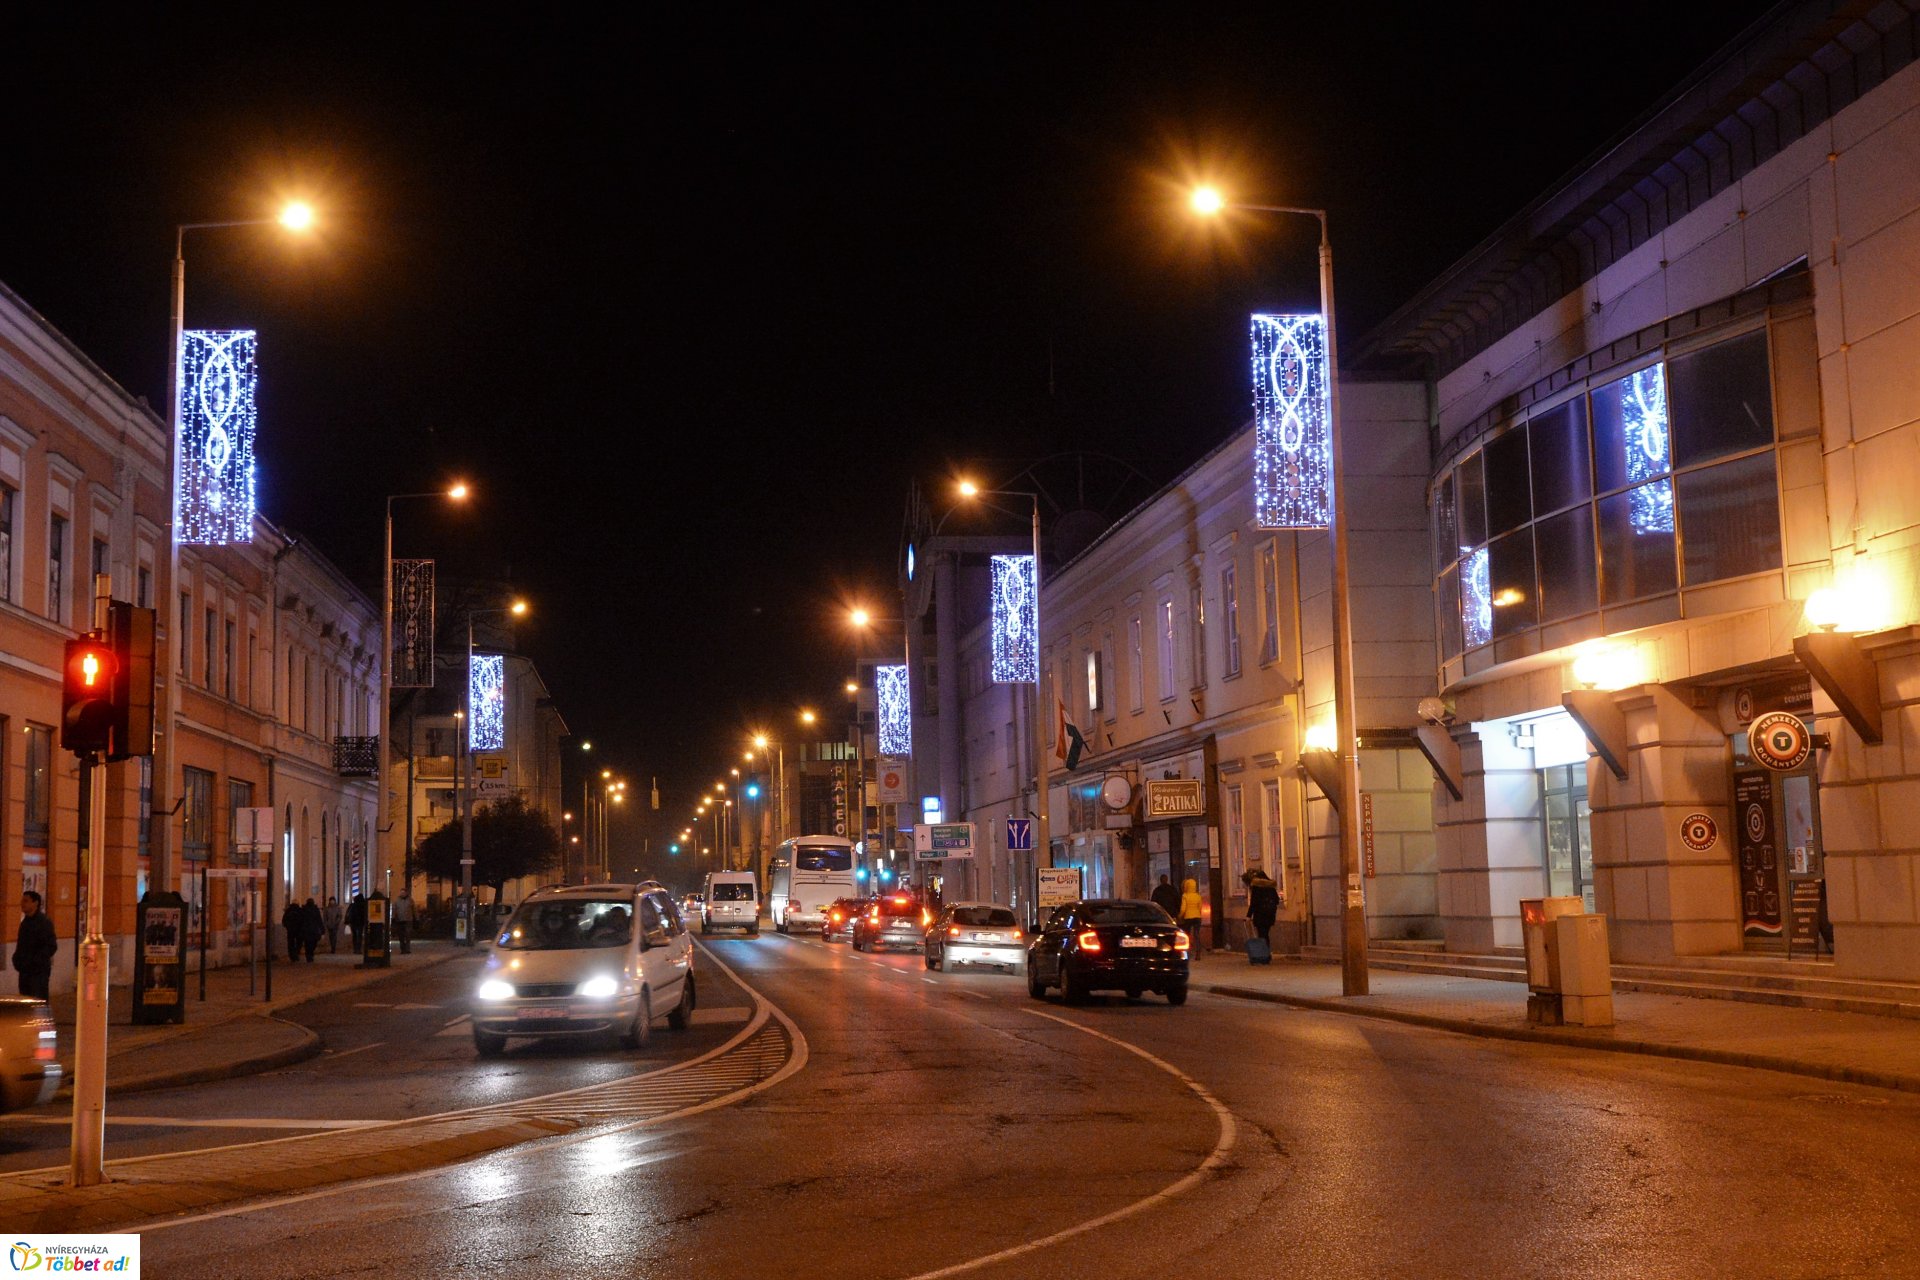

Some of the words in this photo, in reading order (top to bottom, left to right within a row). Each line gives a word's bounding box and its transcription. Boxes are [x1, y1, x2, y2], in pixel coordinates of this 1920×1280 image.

[1761, 715, 1800, 730] NEMZETI
[1777, 736, 1788, 747] T
[1757, 745, 1807, 768] DOHÁNYBOLT
[835, 765, 845, 835] PALEO
[1162, 795, 1198, 811] PATIKA
[1685, 815, 1711, 825] NEMZETI
[1695, 829, 1703, 837] T
